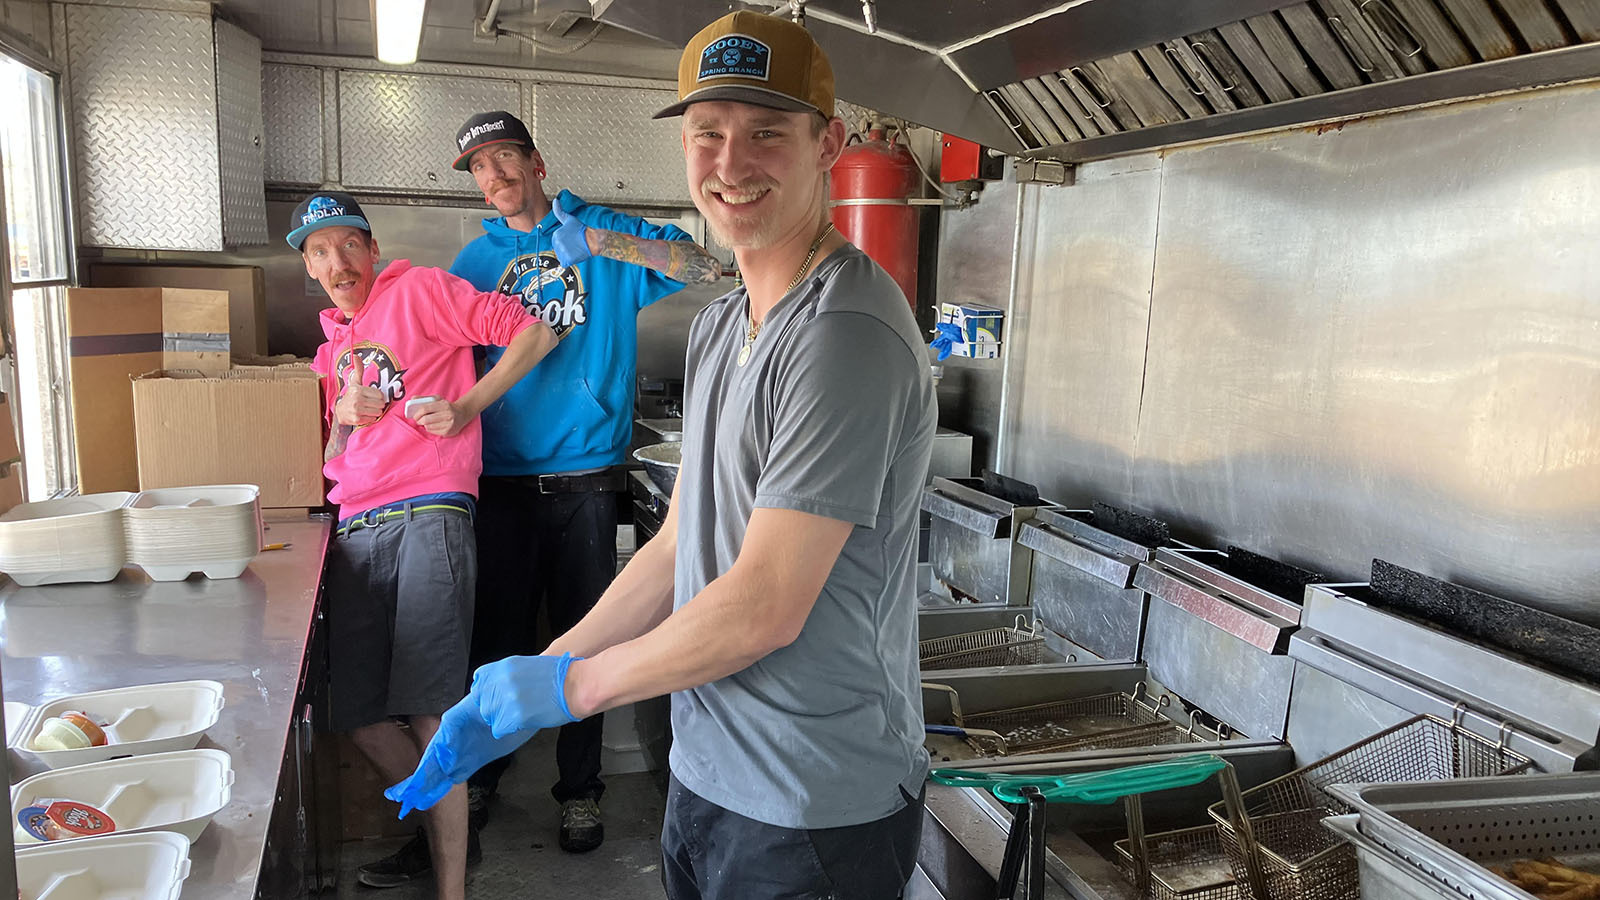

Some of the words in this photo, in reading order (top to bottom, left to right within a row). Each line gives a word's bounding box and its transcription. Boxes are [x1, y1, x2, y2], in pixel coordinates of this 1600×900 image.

[704, 38, 767, 58] HOOEY
[701, 67, 726, 77] SPRING
[728, 67, 764, 76] BRANCH
[519, 289, 587, 327] ook
